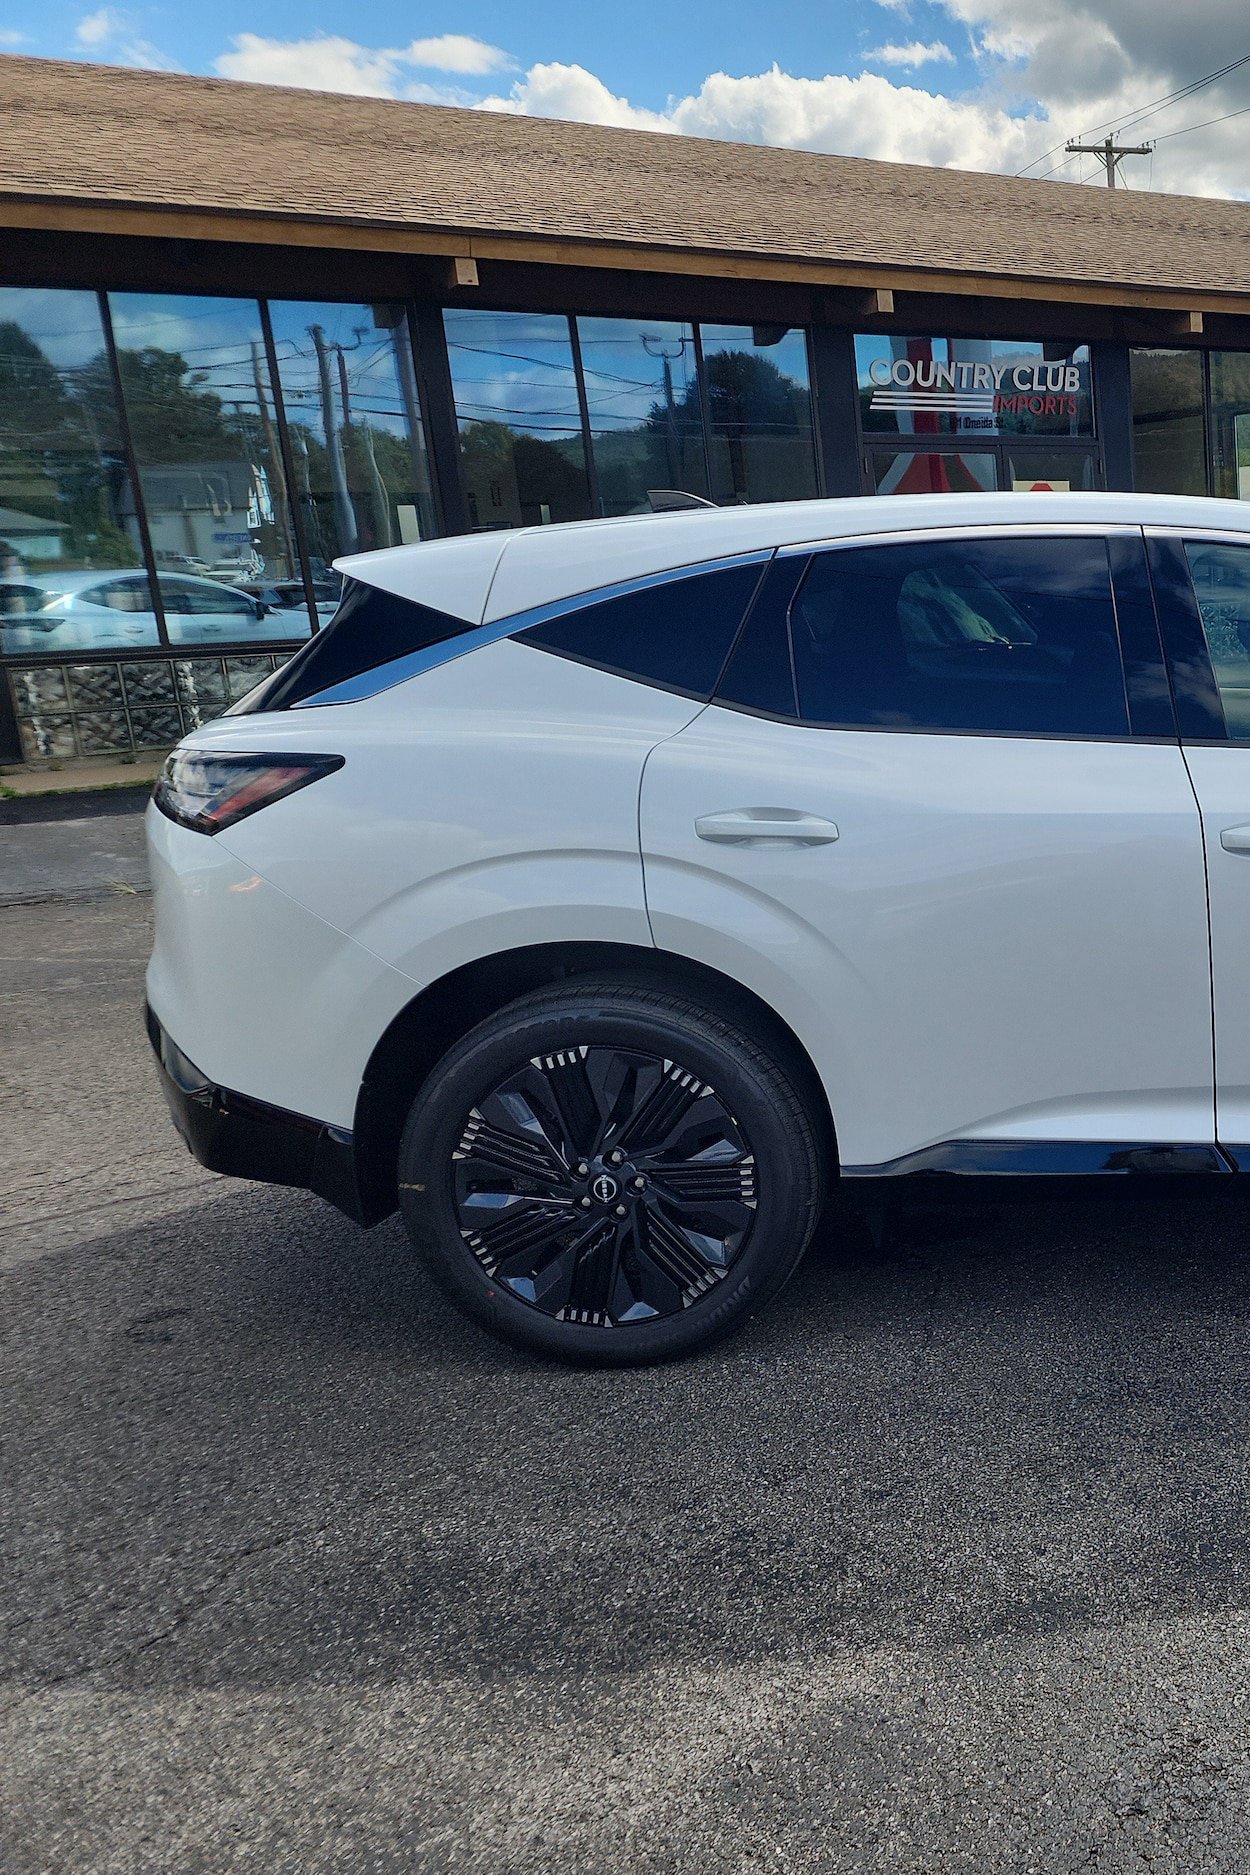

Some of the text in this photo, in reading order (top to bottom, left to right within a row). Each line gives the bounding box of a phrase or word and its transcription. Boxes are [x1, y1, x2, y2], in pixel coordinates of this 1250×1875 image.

[869, 358, 1081, 393] COUNTRY CLUB
[993, 394, 1078, 416] IMPORTS
[963, 416, 993, 429] Oneida
